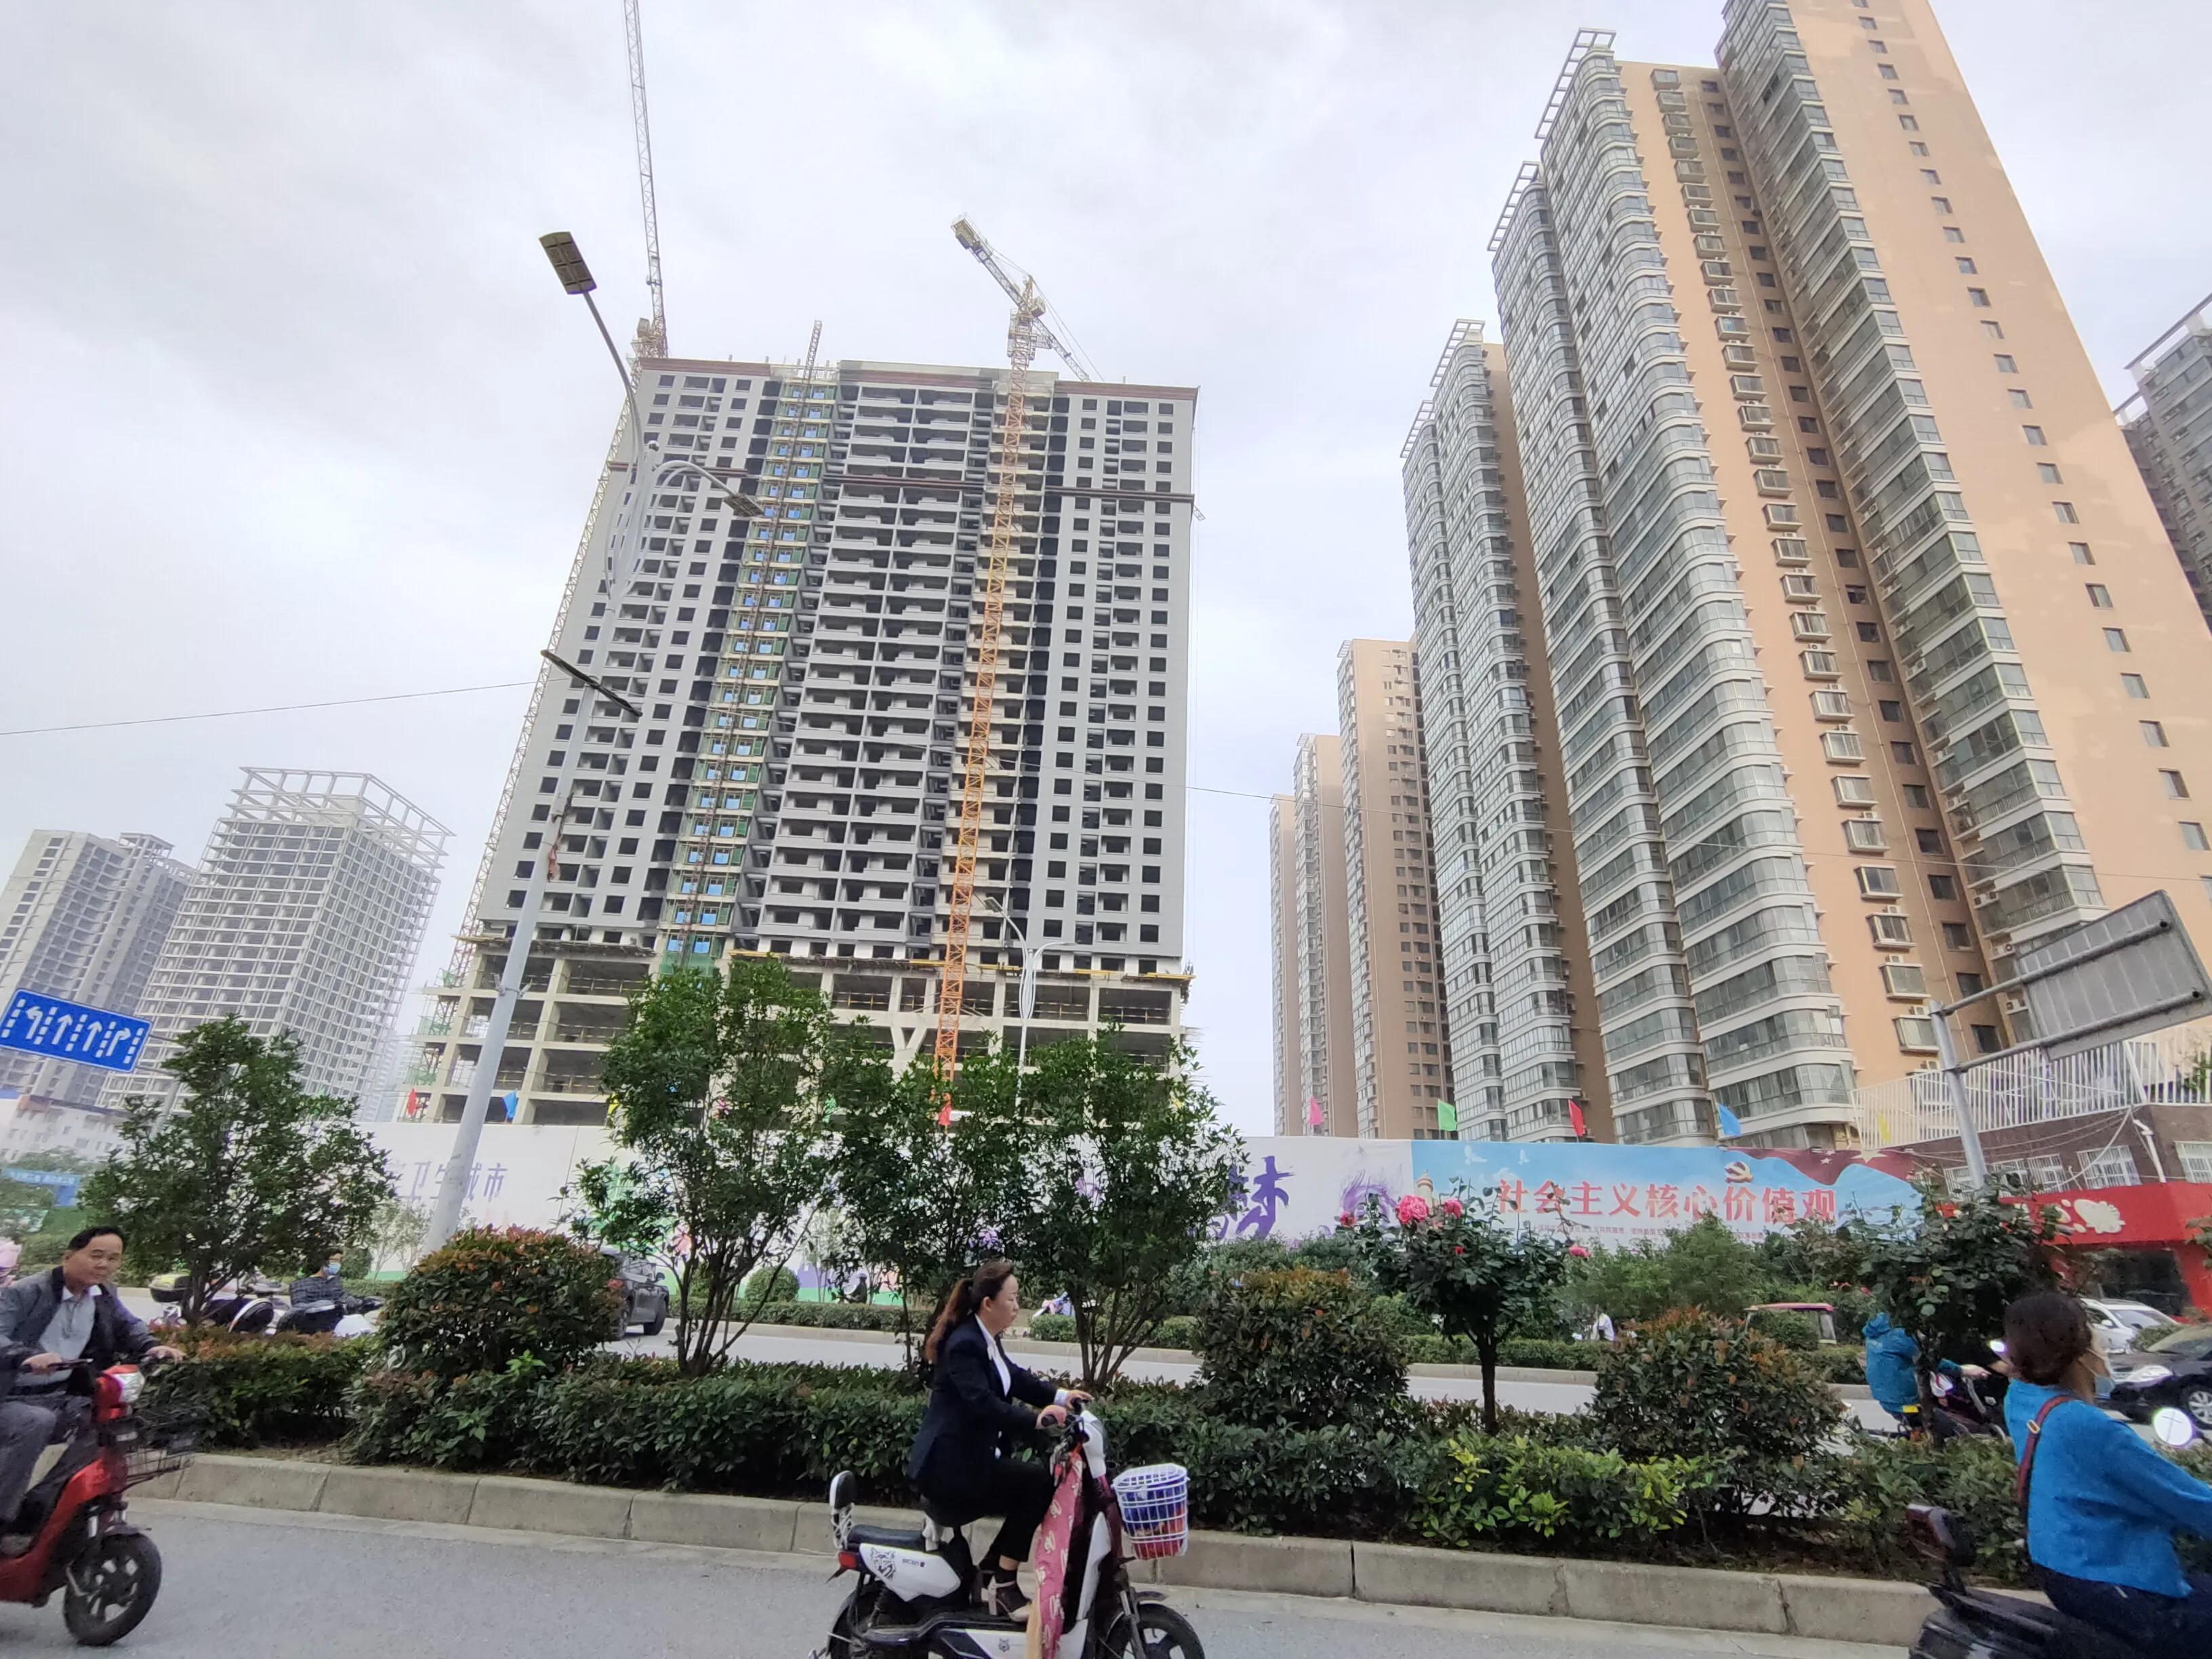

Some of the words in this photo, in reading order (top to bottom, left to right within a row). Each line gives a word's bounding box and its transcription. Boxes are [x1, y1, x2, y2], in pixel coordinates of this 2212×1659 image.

[1499, 1179, 1837, 1225] 社会主义核心价值观
